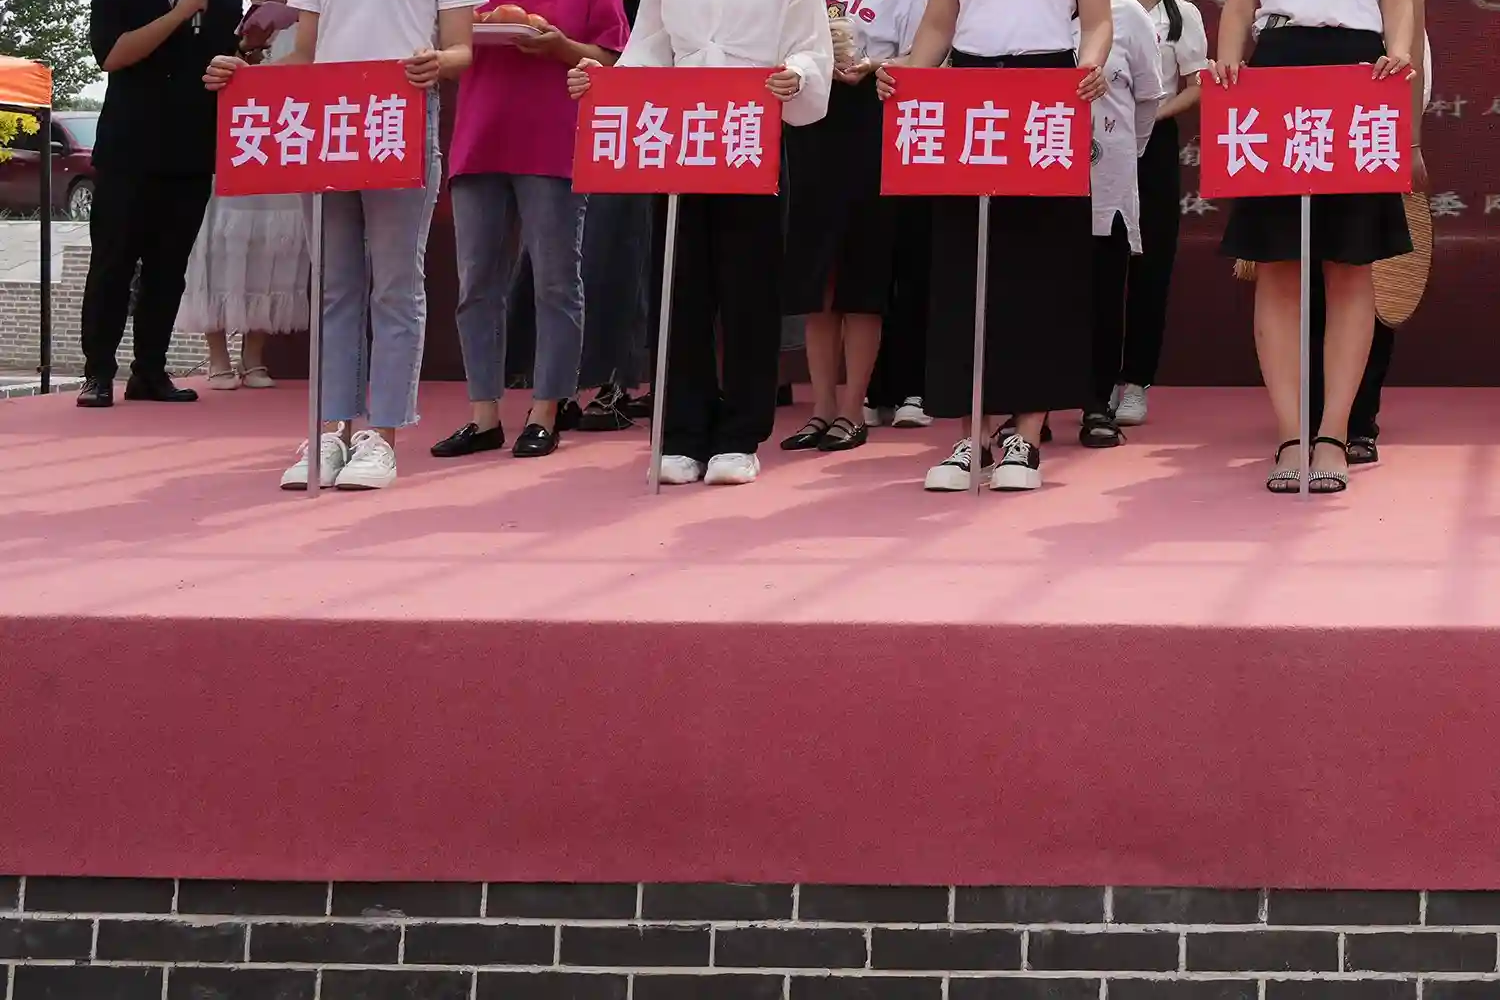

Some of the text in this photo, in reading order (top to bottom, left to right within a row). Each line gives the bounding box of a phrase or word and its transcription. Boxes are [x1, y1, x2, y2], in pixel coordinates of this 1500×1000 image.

[231, 93, 407, 167] 安各庄镇
[591, 101, 764, 169] 司各庄镇
[895, 99, 1075, 169] 程庄镇
[1217, 104, 1400, 176] 长凝镇
